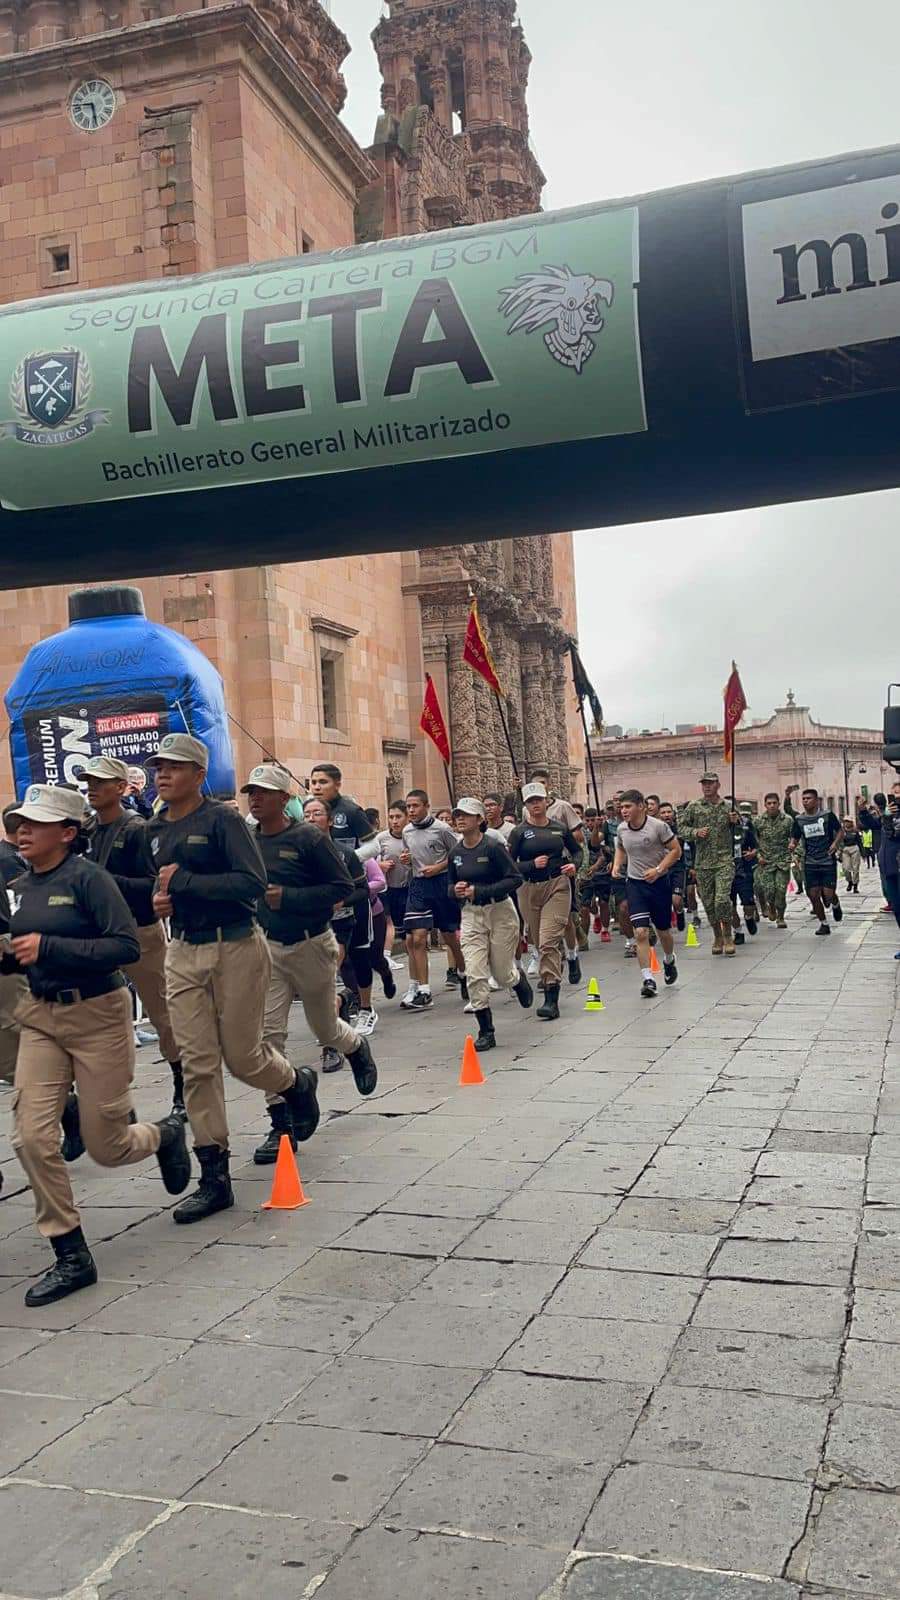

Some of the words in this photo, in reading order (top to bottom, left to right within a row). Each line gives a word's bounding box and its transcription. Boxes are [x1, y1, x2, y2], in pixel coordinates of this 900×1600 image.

[65, 288, 238, 332] Segunda
[253, 258, 413, 302] Carrera
[431, 230, 538, 269] BGM
[127, 278, 496, 436] META
[22, 424, 88, 444] ZACATECAS
[102, 450, 244, 482] Bachillerato
[252, 430, 346, 463] General
[353, 409, 511, 450] Militarizado
[39, 719, 60, 786] REMIUM
[99, 730, 159, 747] MULTIGRADO
